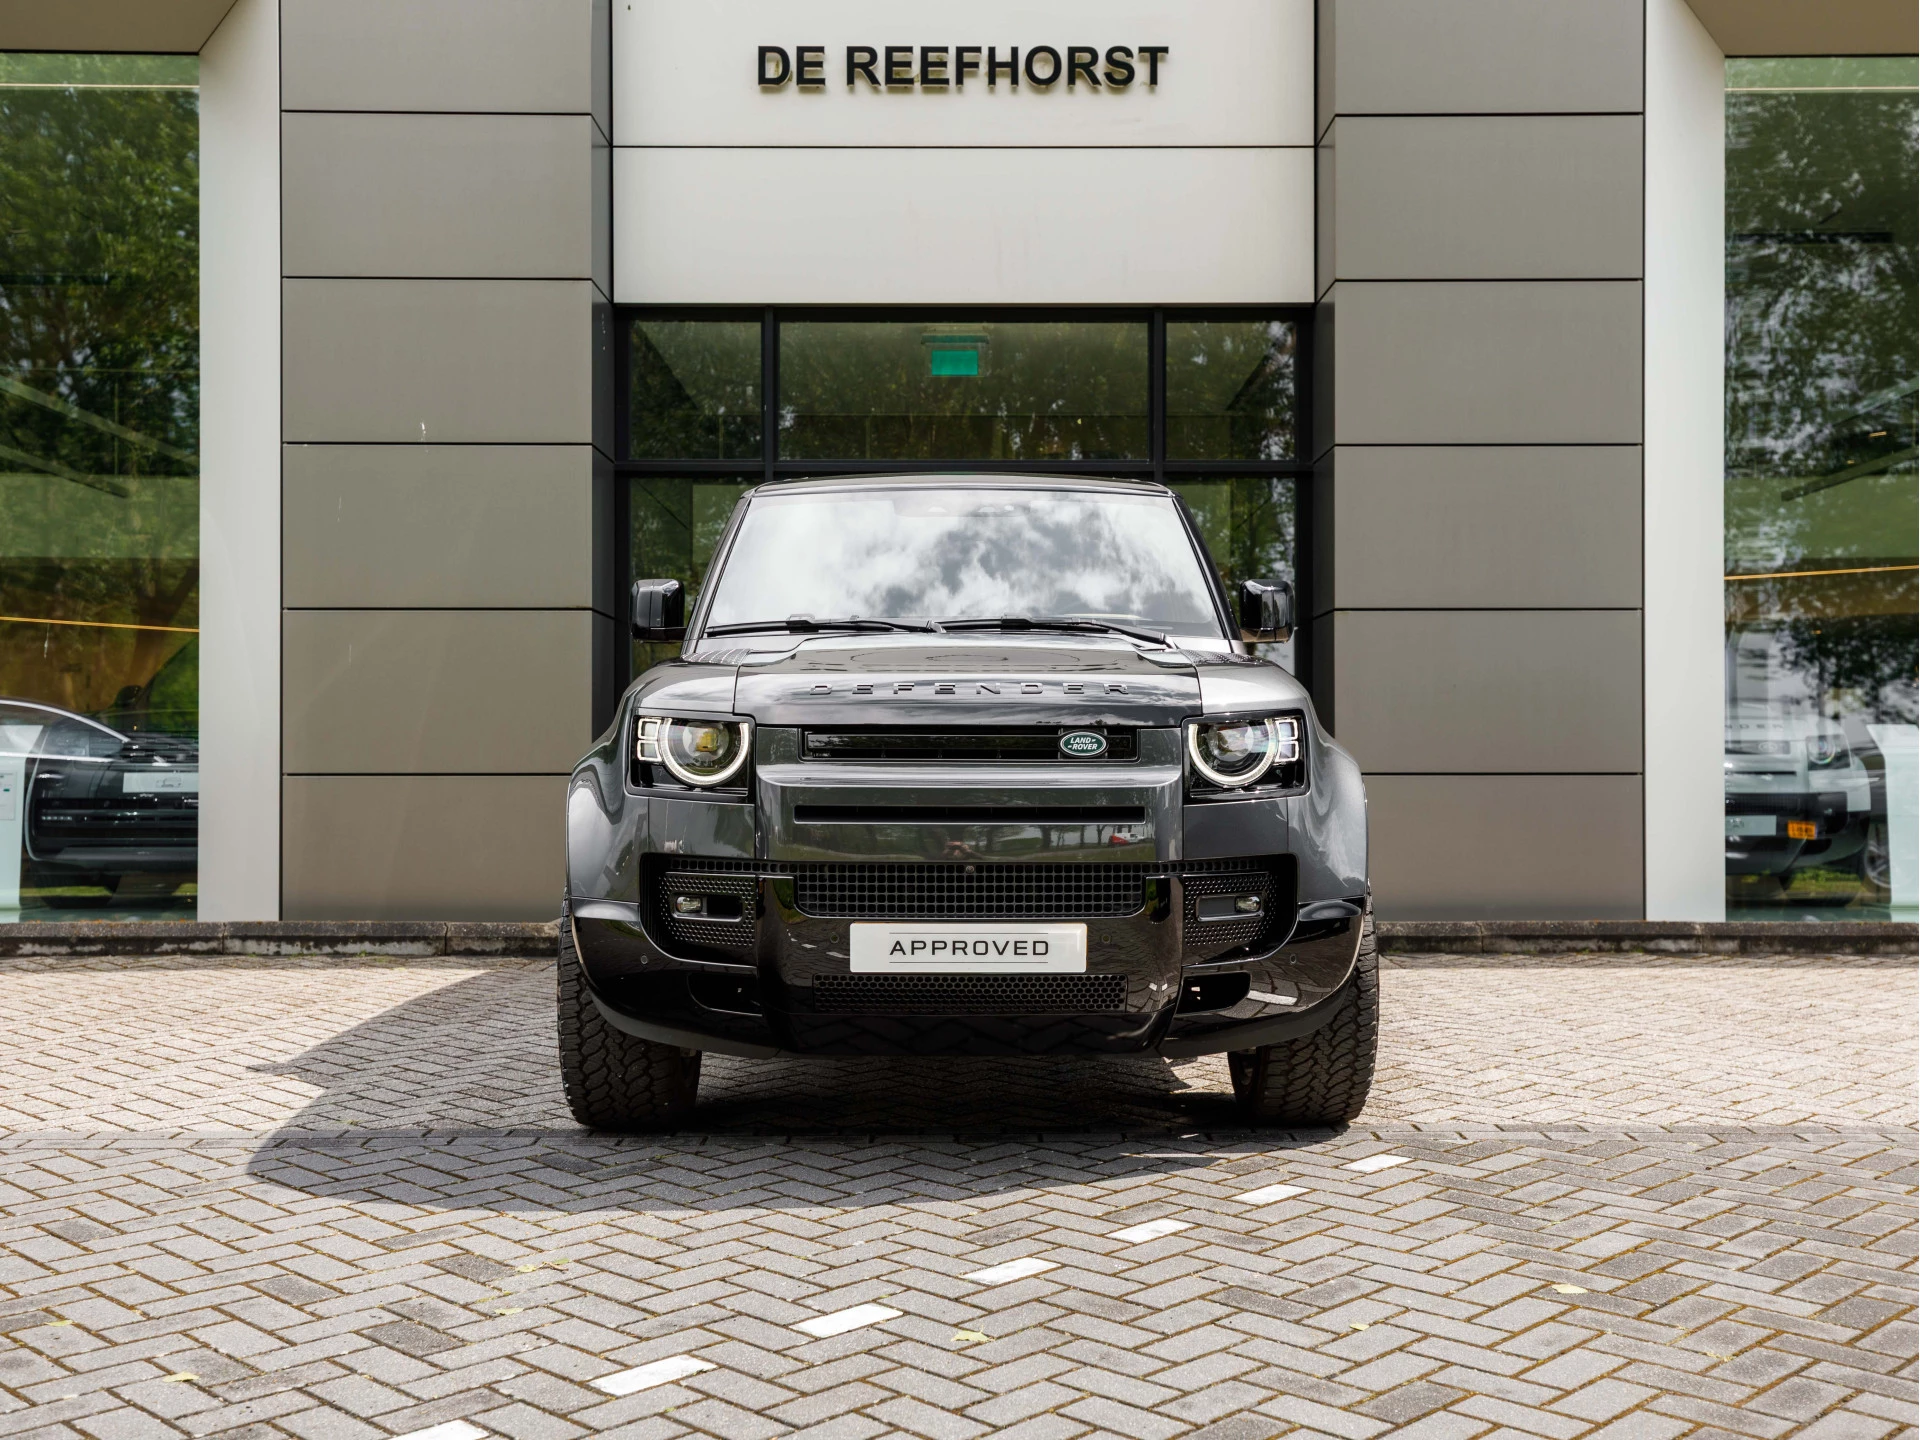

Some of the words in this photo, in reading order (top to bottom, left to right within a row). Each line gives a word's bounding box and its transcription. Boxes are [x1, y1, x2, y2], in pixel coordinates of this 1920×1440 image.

[757, 45, 826, 87] DE
[846, 45, 1169, 87] REEFHORST
[809, 682, 1129, 695] DEFENDER
[889, 940, 1049, 956] APPROVED
